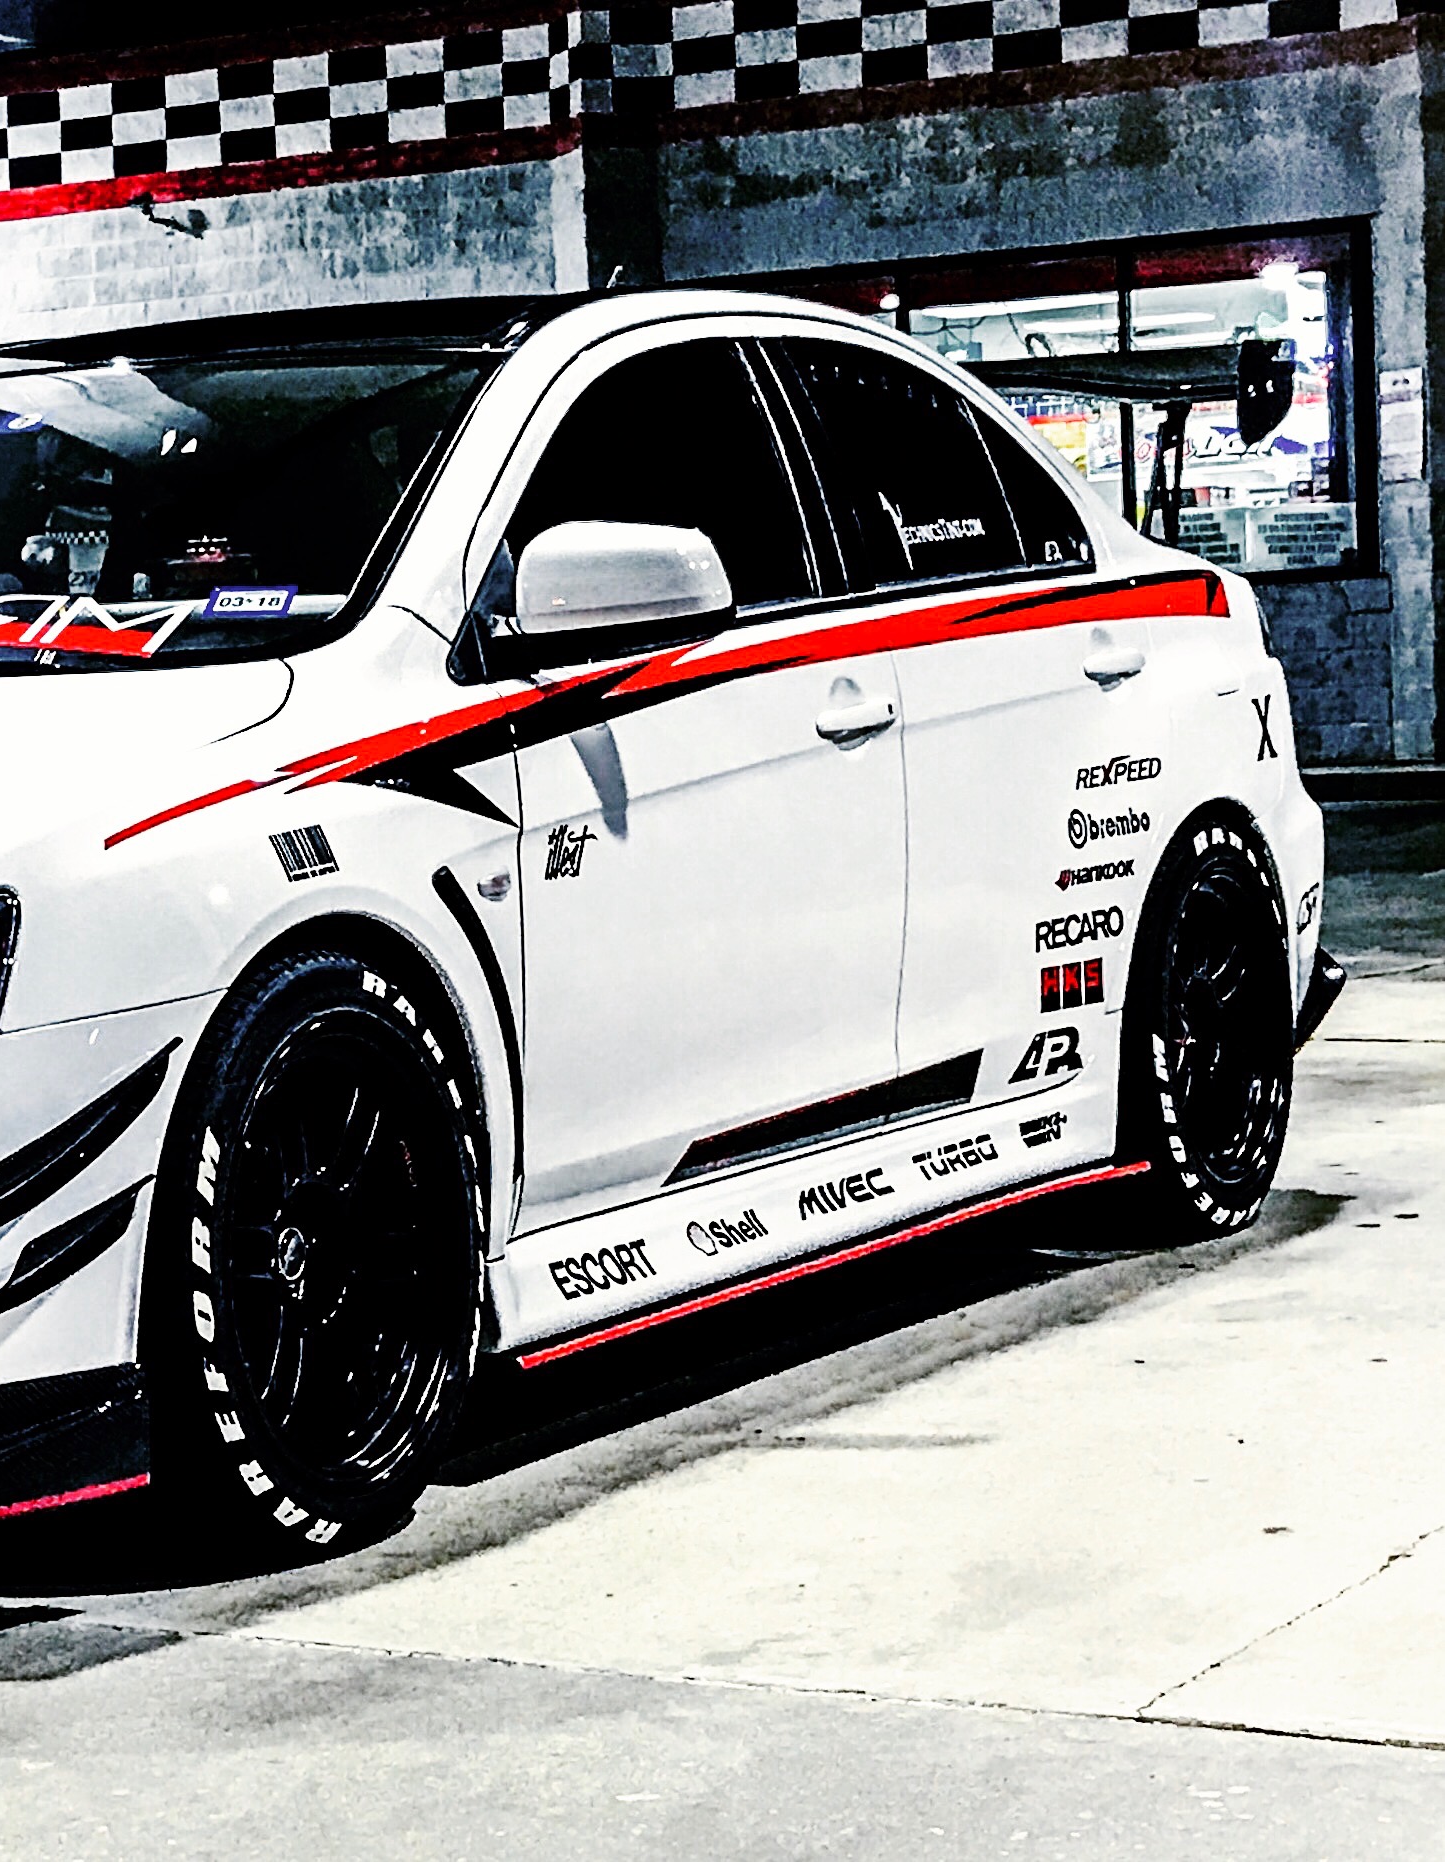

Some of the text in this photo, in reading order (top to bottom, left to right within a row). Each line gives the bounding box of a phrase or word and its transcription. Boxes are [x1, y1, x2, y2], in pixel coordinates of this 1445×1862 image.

[1076, 755, 1161, 790] REXPEED
[1087, 807, 1150, 841] brembo
[1036, 905, 1124, 953] RECARO
[1042, 961, 1100, 996] HKS
[912, 1134, 999, 1181] TURBO
[799, 1167, 895, 1221] MIVEC
[715, 1209, 769, 1249] Shell
[549, 1239, 657, 1301] ESCORT
